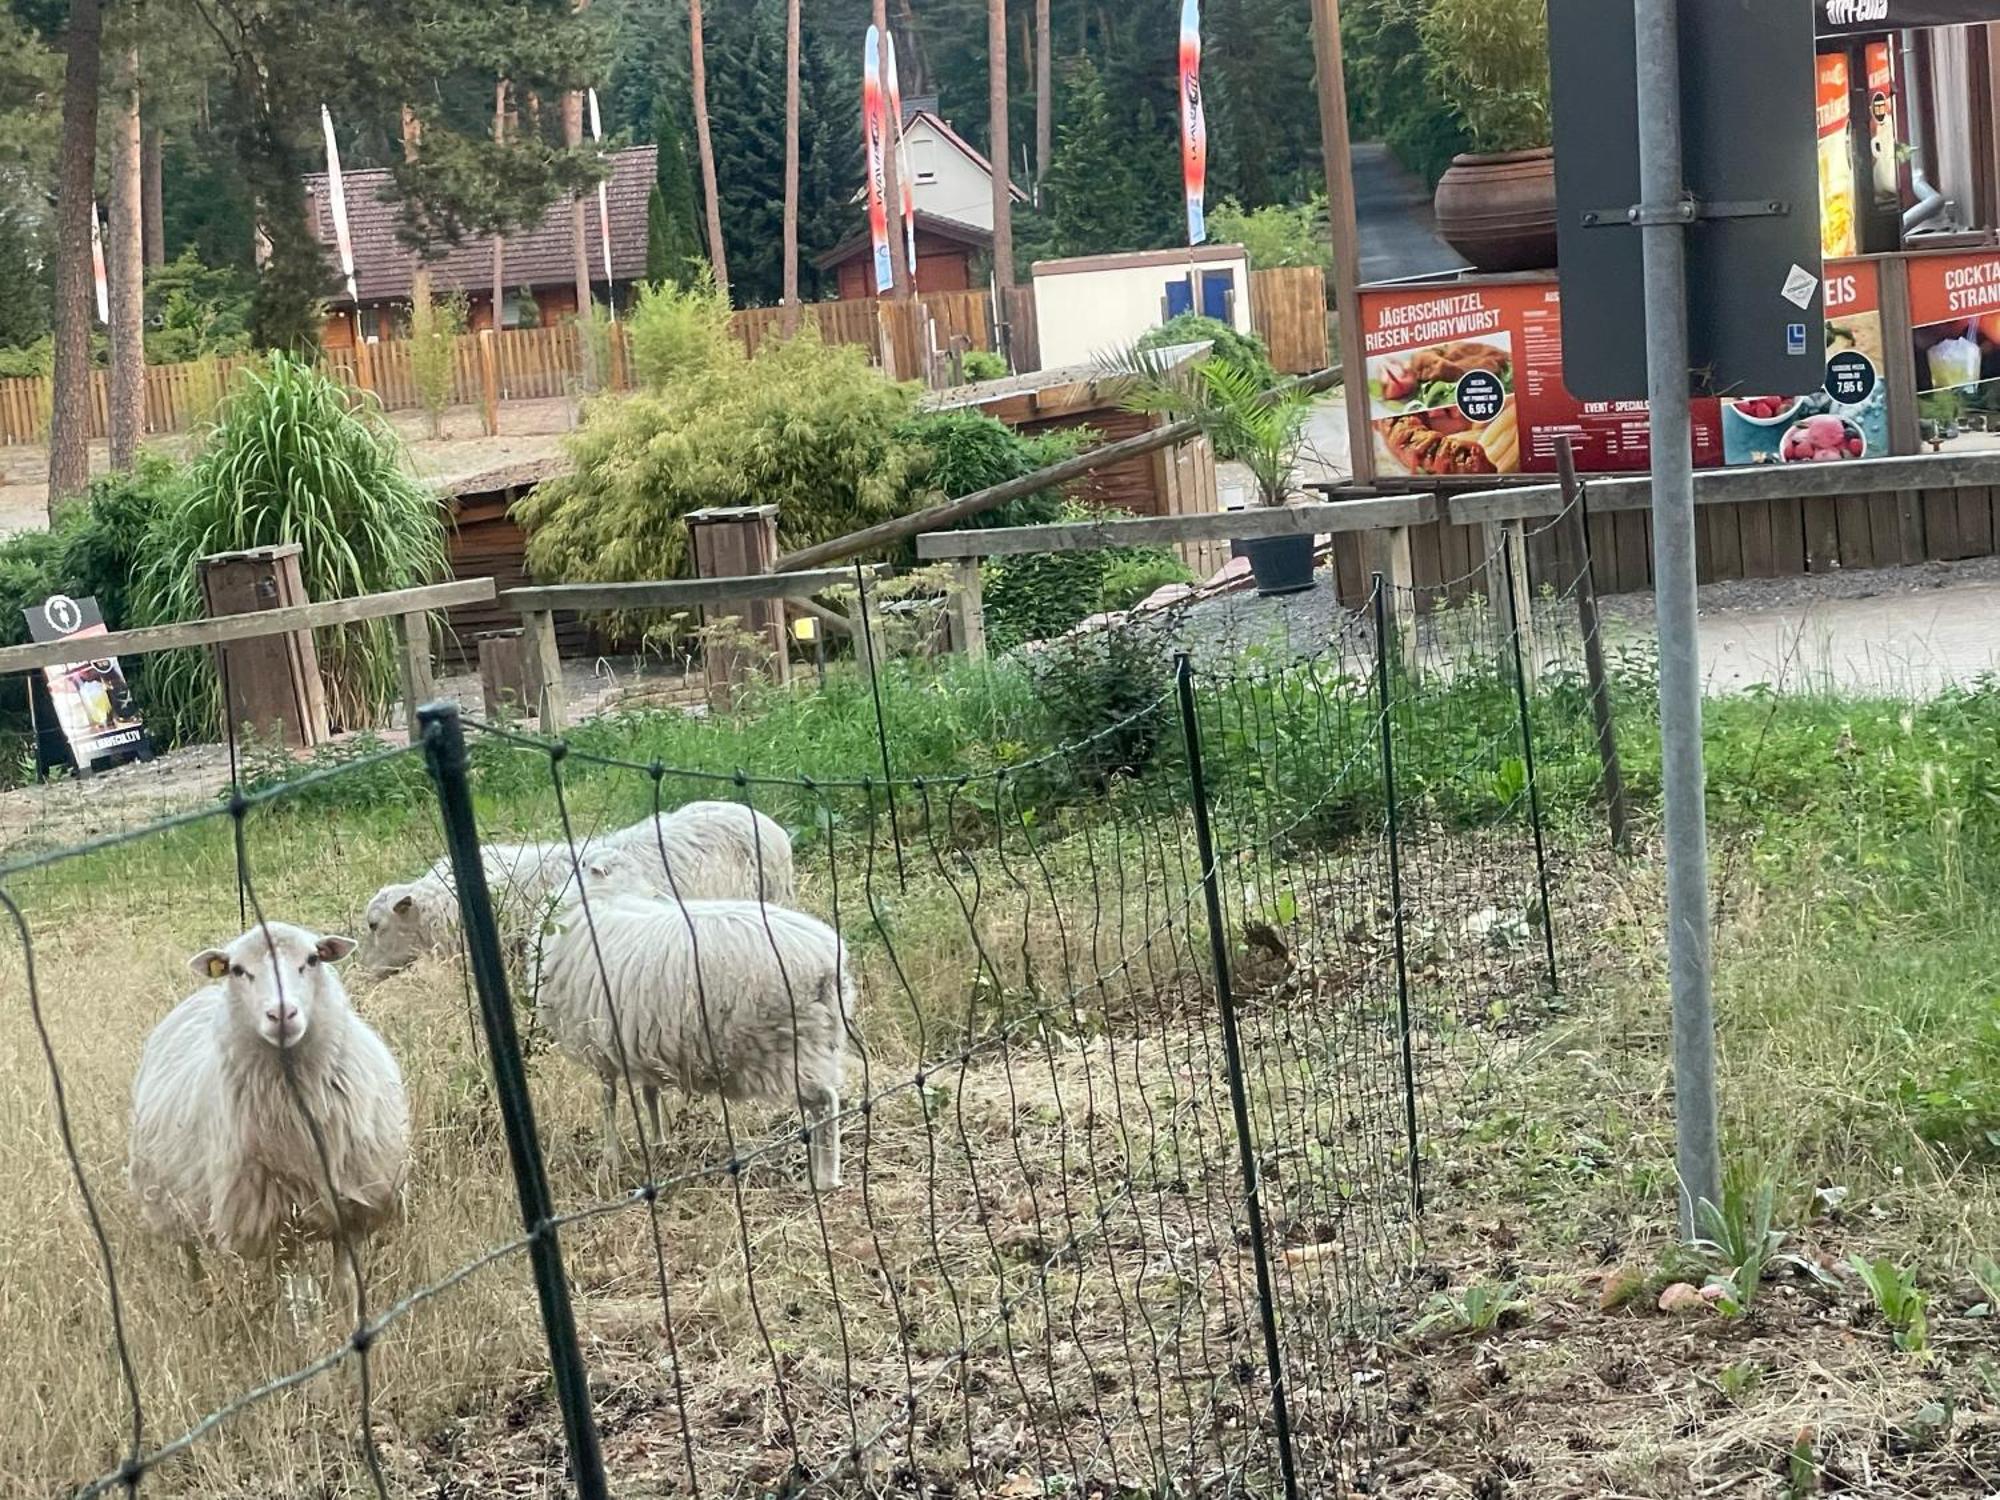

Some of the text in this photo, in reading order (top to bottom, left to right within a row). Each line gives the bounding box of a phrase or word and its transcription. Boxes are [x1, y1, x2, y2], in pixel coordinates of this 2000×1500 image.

[1824, 275, 1856, 307] EIS
[1949, 283, 2000, 311] STRAN
[1378, 292, 1485, 329] JÄGERSCHNITZEL
[1365, 308, 1500, 351] RIESEN-CURRYWURST
[1837, 381, 1855, 394] 7,95
[1468, 403, 1486, 415] 6,95
[1584, 401, 1609, 414] EVENT
